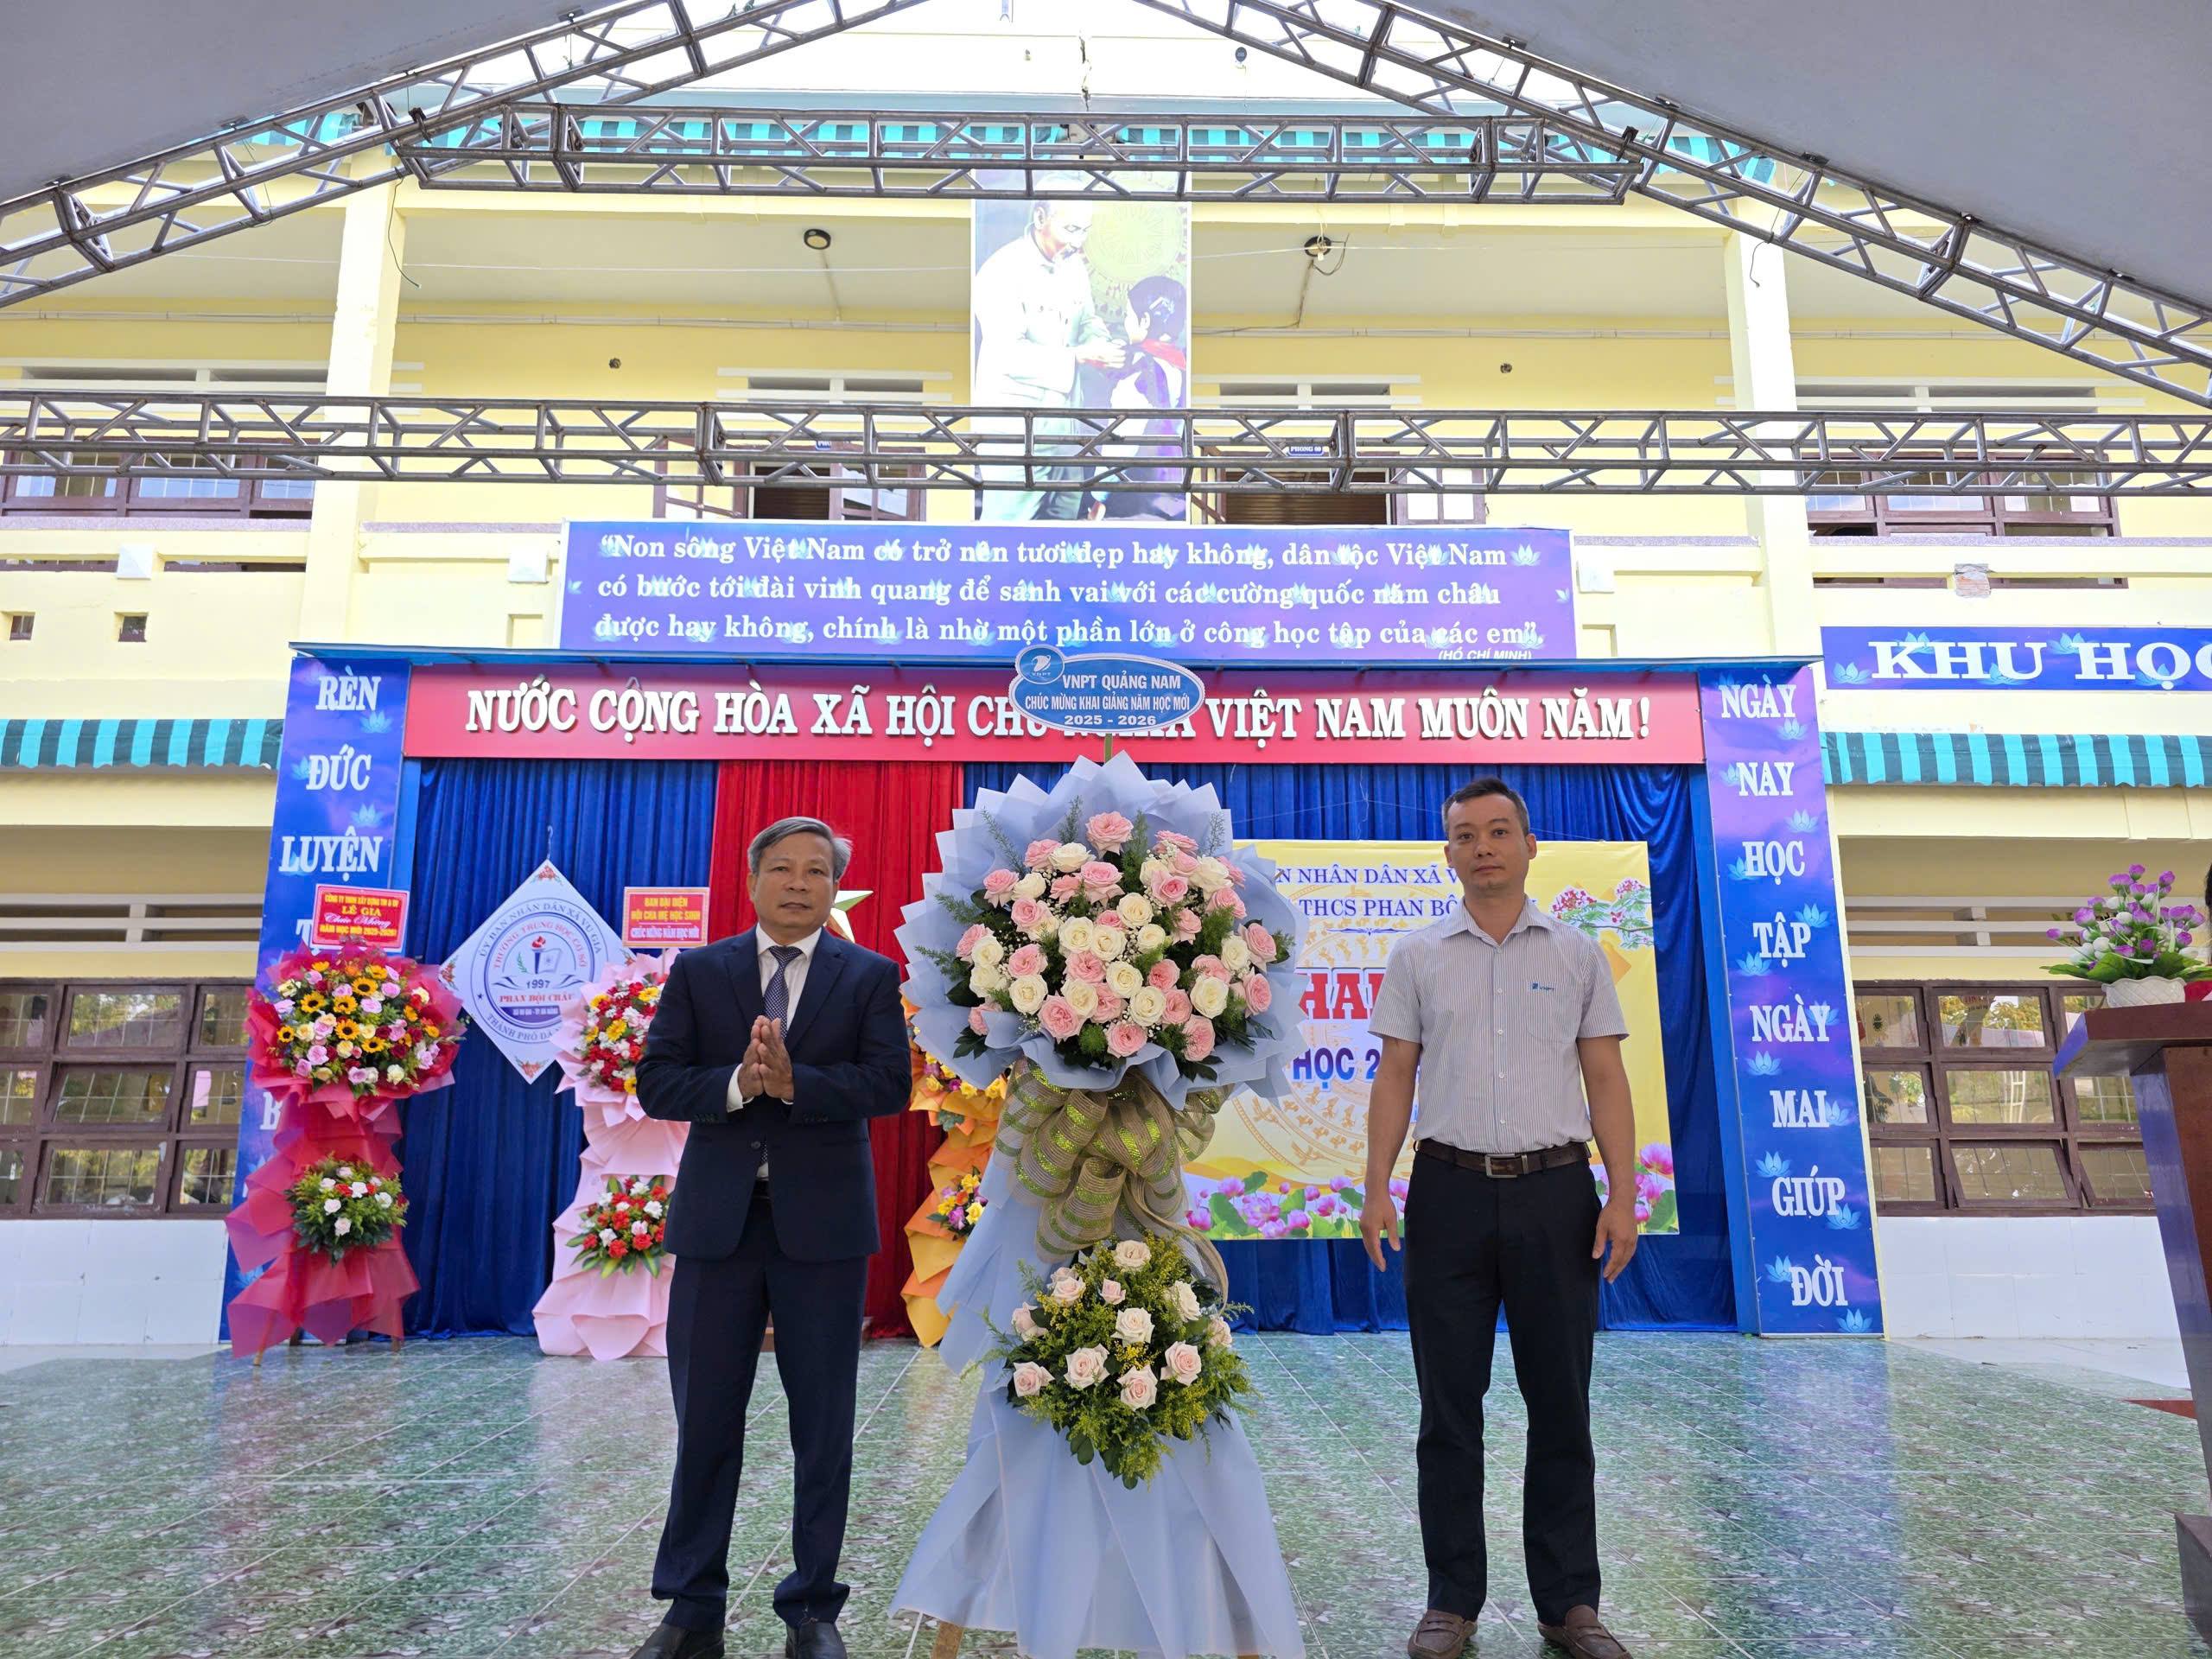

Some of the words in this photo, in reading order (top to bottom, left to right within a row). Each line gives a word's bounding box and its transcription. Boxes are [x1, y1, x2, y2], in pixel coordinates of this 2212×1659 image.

[601, 536, 665, 558] “Non
[675, 536, 734, 563] sông
[744, 537, 798, 563] Việt
[805, 538, 865, 561] Nam
[874, 539, 902, 561] có
[912, 539, 950, 563] trở
[959, 539, 1008, 563] nên
[1017, 542, 1067, 563] tươi
[1080, 542, 1123, 569] đẹp
[1133, 542, 1179, 569] hay
[1186, 541, 1274, 569] không,
[1282, 543, 1331, 566] dân
[1336, 543, 1379, 569] tộc
[1387, 543, 1437, 569] Việt
[1447, 543, 1507, 566] Nam
[598, 576, 627, 597] có
[637, 575, 700, 598] bước
[709, 577, 744, 598] tới
[754, 576, 795, 599] đài
[804, 576, 862, 600] vinh
[871, 581, 950, 606] quang
[959, 576, 991, 601] để
[1000, 578, 1061, 602] sánh
[1070, 582, 1108, 603] vai
[1119, 581, 1156, 604] với
[1166, 582, 1209, 604] các
[1217, 582, 1293, 610] cường
[1303, 579, 1364, 610] quốc
[1373, 582, 1429, 605] năm
[1438, 581, 1500, 605] châu
[595, 613, 659, 643] được
[668, 614, 716, 642] hay
[725, 614, 814, 644] không,
[823, 616, 898, 640] chính
[906, 616, 929, 639] là
[938, 618, 988, 641] nhờ
[997, 620, 1047, 646] một
[1056, 616, 1122, 648] phần
[1129, 619, 1171, 643] lớn
[1179, 620, 1195, 644] ở
[1204, 622, 1264, 649] công
[1274, 620, 1320, 649] học
[1328, 621, 1370, 648] tập
[1380, 620, 1426, 644] của
[1435, 623, 1478, 645] các
[1486, 622, 1543, 645] em”.
[1868, 641, 2047, 679] KHU
[315, 665, 381, 711] RÈN
[1062, 675, 1097, 690] VNPT
[1101, 671, 1147, 690] QUẢNG
[1151, 675, 1181, 690] NAM
[1721, 674, 1796, 718] NGÀY
[466, 674, 578, 733] NƯỚC
[588, 677, 701, 742] CỘNG
[714, 680, 798, 734] HÒA
[811, 686, 873, 735] XÃ
[885, 684, 956, 747] HỘI
[968, 695, 1048, 737] CH
[1205, 687, 1301, 749] VIỆT
[1315, 698, 1406, 739] NAM
[1420, 686, 1529, 740] MUÔN
[1541, 687, 1649, 740] NĂM!
[1025, 693, 1049, 710] CHÚC
[1051, 693, 1077, 710] MỪNG
[1079, 696, 1100, 710] KHAI
[1103, 691, 1128, 711] GIẢNG
[1130, 694, 1151, 711] NĂM
[1153, 696, 1171, 714] HỌC
[1173, 693, 1191, 711] MỚI
[1064, 715, 1103, 725] 2025
[1118, 715, 1156, 726] 2026
[306, 743, 372, 791] ĐỨC
[1737, 761, 1795, 796] NAY
[278, 825, 383, 882] LUYỆN
[1742, 840, 1805, 885] HỌC
[1299, 865, 1357, 883] NHÂN
[1363, 865, 1409, 884] DÂN
[1413, 866, 1440, 884] XÃ
[341, 905, 357, 914] LÊ
[360, 907, 381, 916] GIA
[1300, 899, 1356, 916] THCS
[1363, 899, 1423, 916] PHAN
[1752, 912, 1811, 968] TẬP
[526, 979, 550, 988] 1997
[1750, 994, 1830, 1042] NGÀY
[1293, 1047, 1355, 1090] HỌC
[1770, 1090, 1829, 1128] MAI
[1771, 1165, 1845, 1216] GIÚP
[1789, 1254, 1848, 1306] ĐỜI
